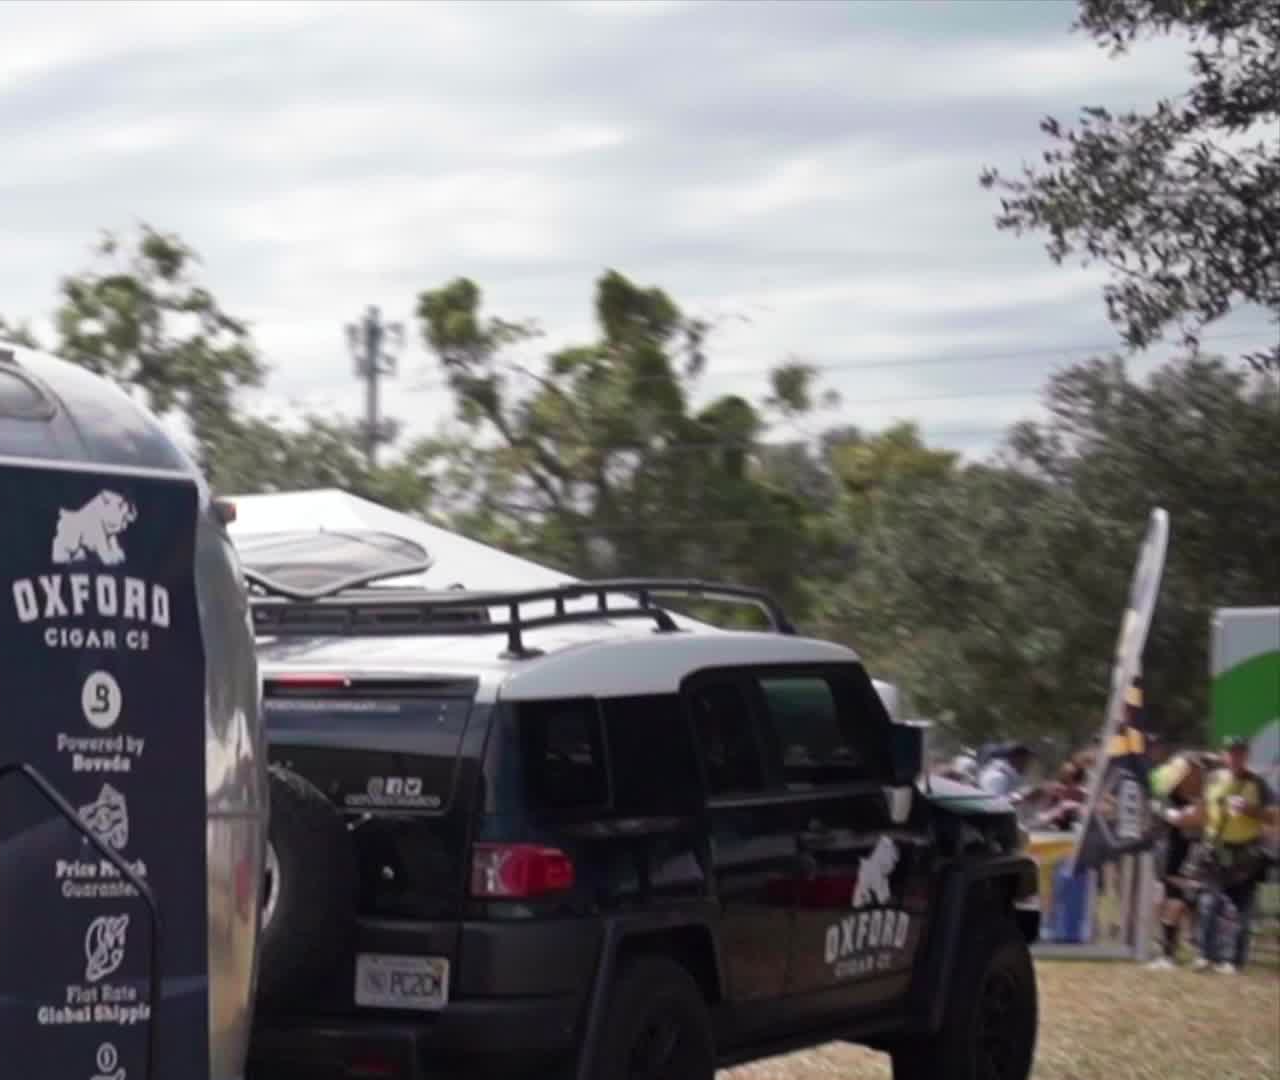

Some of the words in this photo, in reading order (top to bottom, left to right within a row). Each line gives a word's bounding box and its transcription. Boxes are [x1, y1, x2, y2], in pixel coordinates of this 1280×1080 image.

[13, 573, 170, 628] OXFORD
[44, 628, 116, 648] CIGAR
[57, 733, 123, 752] Powered
[127, 735, 145, 757] by
[72, 754, 131, 771] Boveda
[56, 859, 97, 878] Price
[100, 859, 147, 878] Mch
[824, 909, 910, 964] OXFORD
[67, 985, 97, 1003] Flat
[101, 984, 137, 1002] Rate
[37, 1005, 91, 1023] Global
[94, 1003, 151, 1024] Shippi
